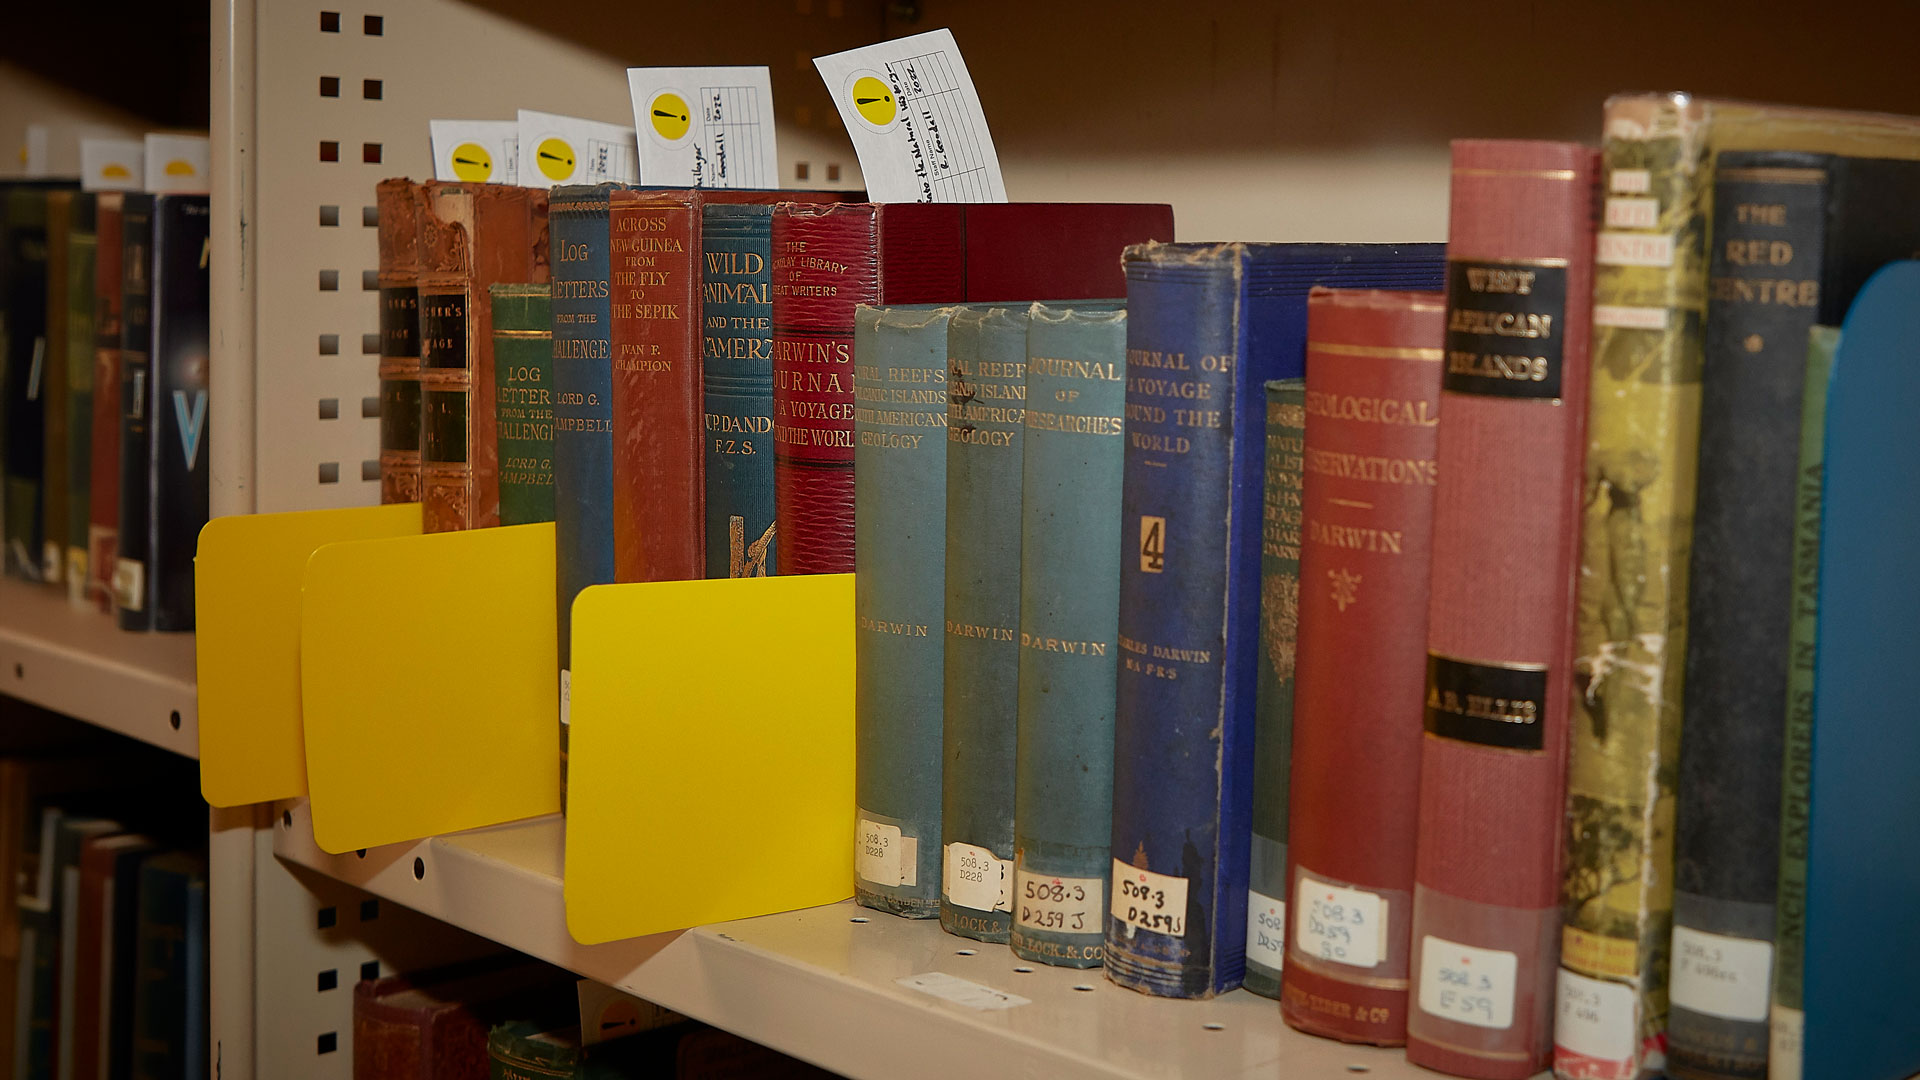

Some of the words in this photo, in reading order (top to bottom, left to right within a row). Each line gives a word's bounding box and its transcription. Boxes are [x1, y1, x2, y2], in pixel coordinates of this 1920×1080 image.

[903, 81, 912, 96] Date
[925, 139, 936, 159] Name
[930, 158, 940, 177] Staff
[615, 216, 667, 232] ACROSS
[1736, 202, 1788, 228] THE
[560, 239, 589, 262] LOG
[611, 238, 629, 252] NEW
[631, 237, 684, 252] GUINEA
[785, 241, 808, 254] THE
[1726, 239, 1794, 268] RED
[625, 256, 655, 267] FROM
[705, 252, 765, 275] WILD
[800, 256, 849, 275] LIBRARY
[614, 271, 636, 286] THE
[639, 271, 671, 286] FLY
[788, 270, 802, 283] OF
[1467, 267, 1536, 296] WEST
[551, 276, 609, 299] LETTERS
[630, 289, 645, 300] TO
[791, 285, 838, 297] WRITERS
[556, 314, 576, 324] FROM
[577, 314, 598, 324] THE
[612, 303, 632, 319] THE
[635, 303, 680, 320] SEPIK
[705, 316, 728, 330] AND
[729, 316, 771, 330] THE
[427, 338, 453, 350] AGE
[621, 344, 645, 355] IVAN
[650, 344, 661, 356] F.
[615, 360, 673, 372] CHAMPION
[949, 357, 973, 376] RAL
[978, 361, 1027, 379] REEF
[1029, 357, 1122, 382] JOURNAL
[1127, 349, 1191, 371] OURNAL
[1200, 354, 1234, 373] OF
[1449, 351, 1549, 382] ISLANDS
[508, 366, 541, 382] LOG
[891, 388, 947, 405] ISLANDS
[949, 380, 978, 397] ANIC
[1055, 389, 1081, 403] OF
[1136, 377, 1213, 400] VOYAGE
[557, 392, 584, 406] LORD
[587, 393, 600, 406] G.
[501, 407, 526, 419] FROM
[528, 408, 554, 420] THE
[779, 400, 788, 416] A
[790, 400, 855, 421] VOYAGE
[875, 409, 947, 428] AMERICAN
[1172, 408, 1222, 429] THE
[498, 421, 554, 441] ALLENG
[787, 426, 810, 446] THE
[811, 428, 855, 449] WORL
[861, 431, 924, 449] GEOLOGY
[949, 426, 1015, 448] GEOLOGY
[715, 438, 757, 456] F.Z.S.
[1131, 431, 1192, 454] WORLD
[505, 457, 537, 470] LORD
[540, 458, 552, 470] G.
[500, 471, 554, 485] AMPBEL
[1142, 521, 1165, 570] 4
[1309, 519, 1402, 555] DARWIN
[1797, 462, 1823, 618] TASMANIA
[861, 616, 929, 638] DARWIN
[946, 619, 1014, 642] DARWIN
[1020, 632, 1107, 657] DARWIN
[1153, 645, 1211, 665] DARWIN
[1795, 641, 1816, 671] IN
[1786, 690, 1813, 861] EXPLORERS
[865, 832, 890, 849] 508.3
[865, 845, 885, 859] D228
[960, 856, 991, 873] 508.3
[959, 869, 984, 884] D228
[1025, 880, 1086, 903] 508.3
[1122, 879, 1165, 910] 508.3
